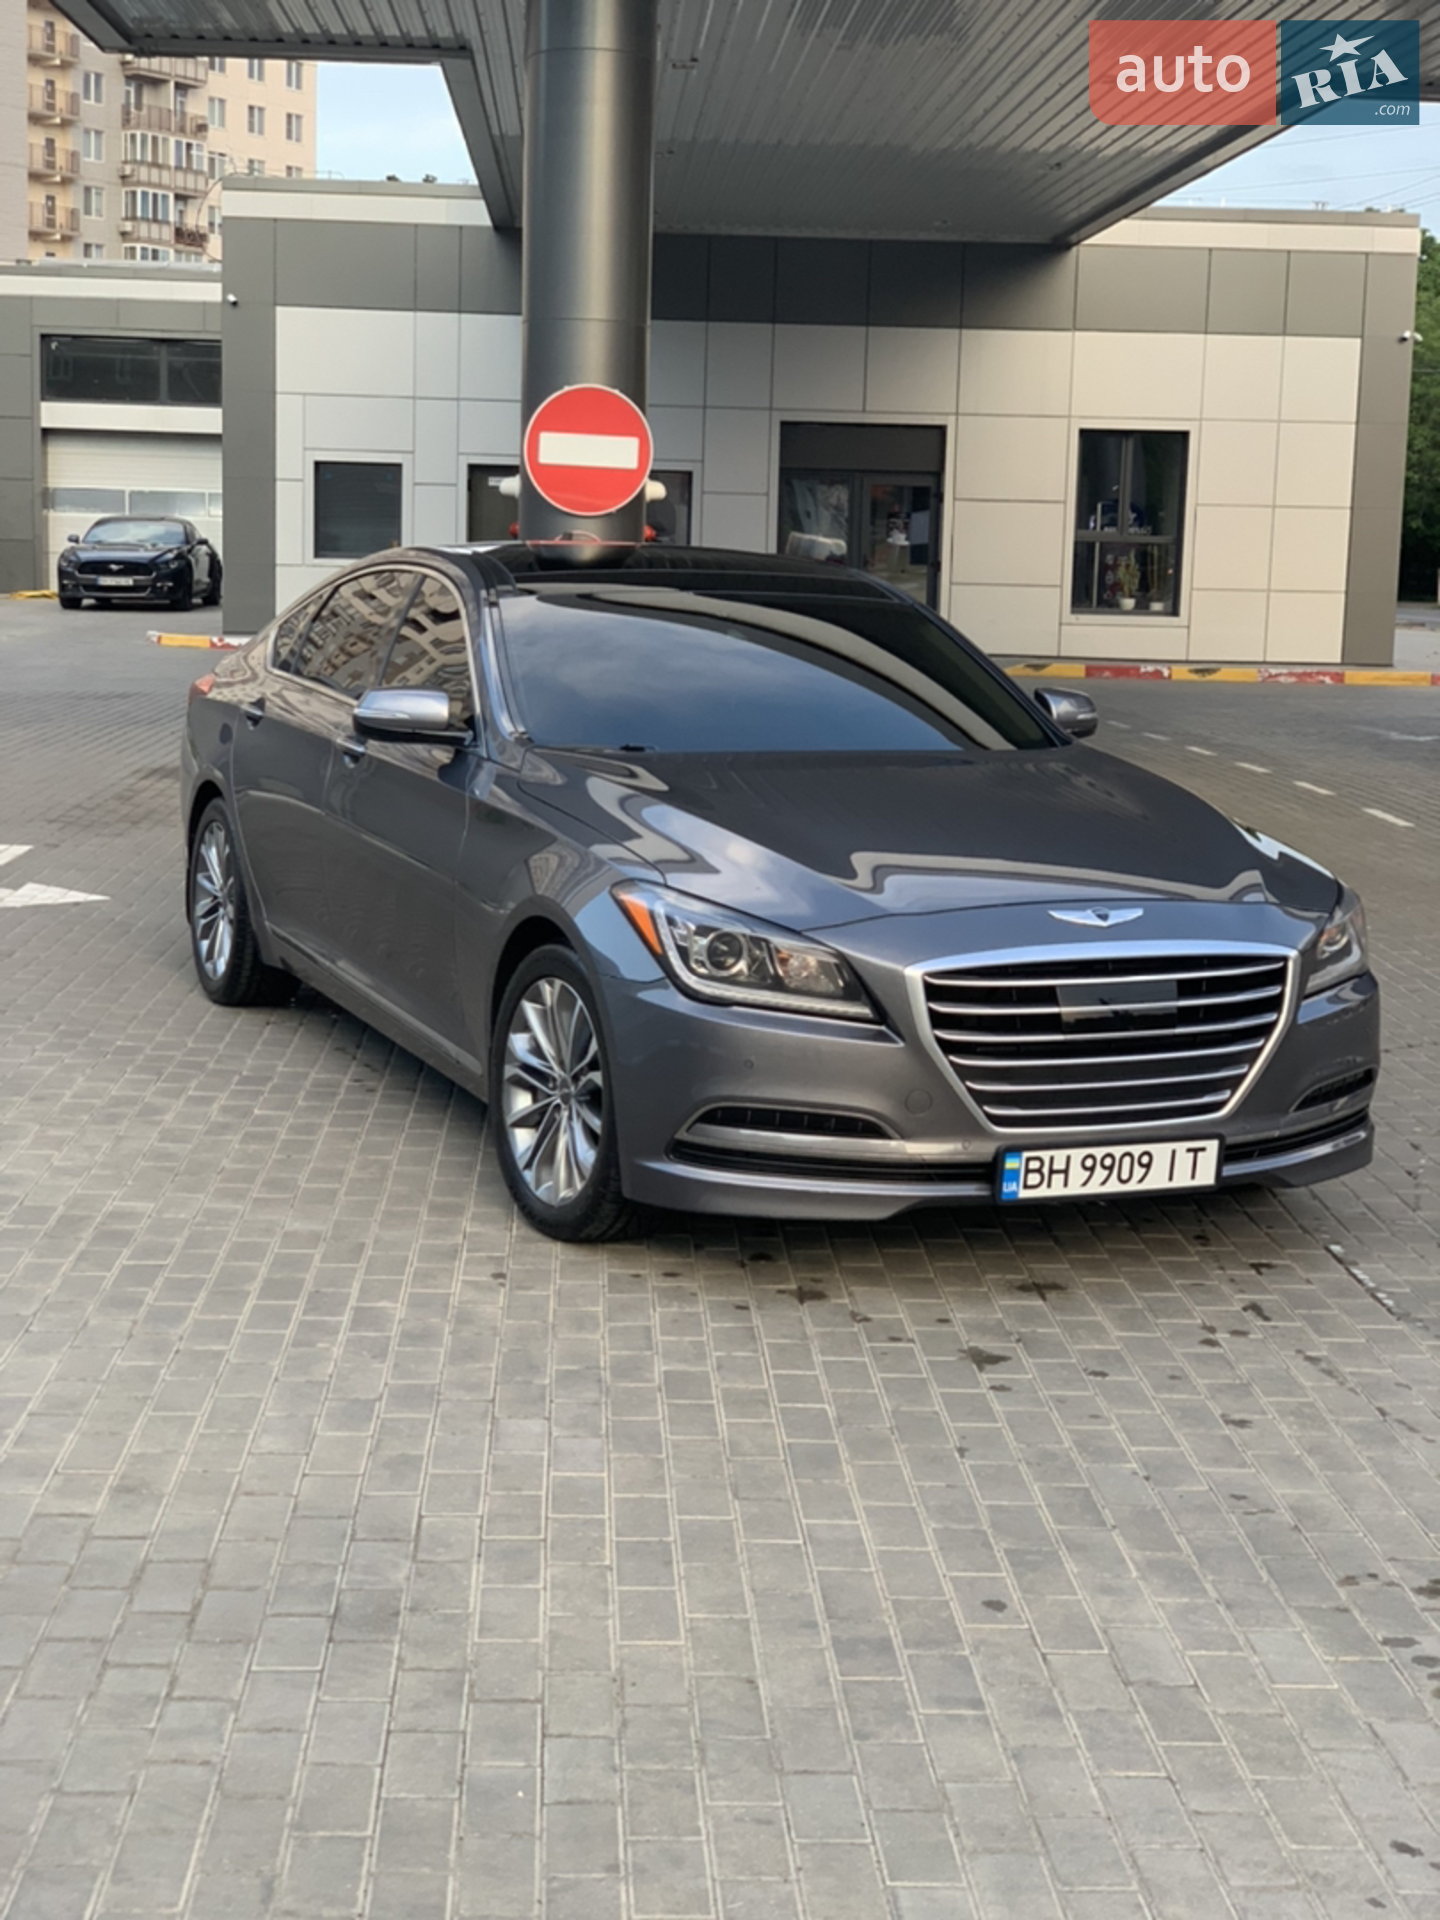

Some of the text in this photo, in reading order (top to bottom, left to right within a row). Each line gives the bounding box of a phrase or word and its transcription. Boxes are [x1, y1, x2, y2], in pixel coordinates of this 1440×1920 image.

[1023, 1147, 1207, 1190] BH 9909 IT
[1003, 1181, 1018, 1192] UA
